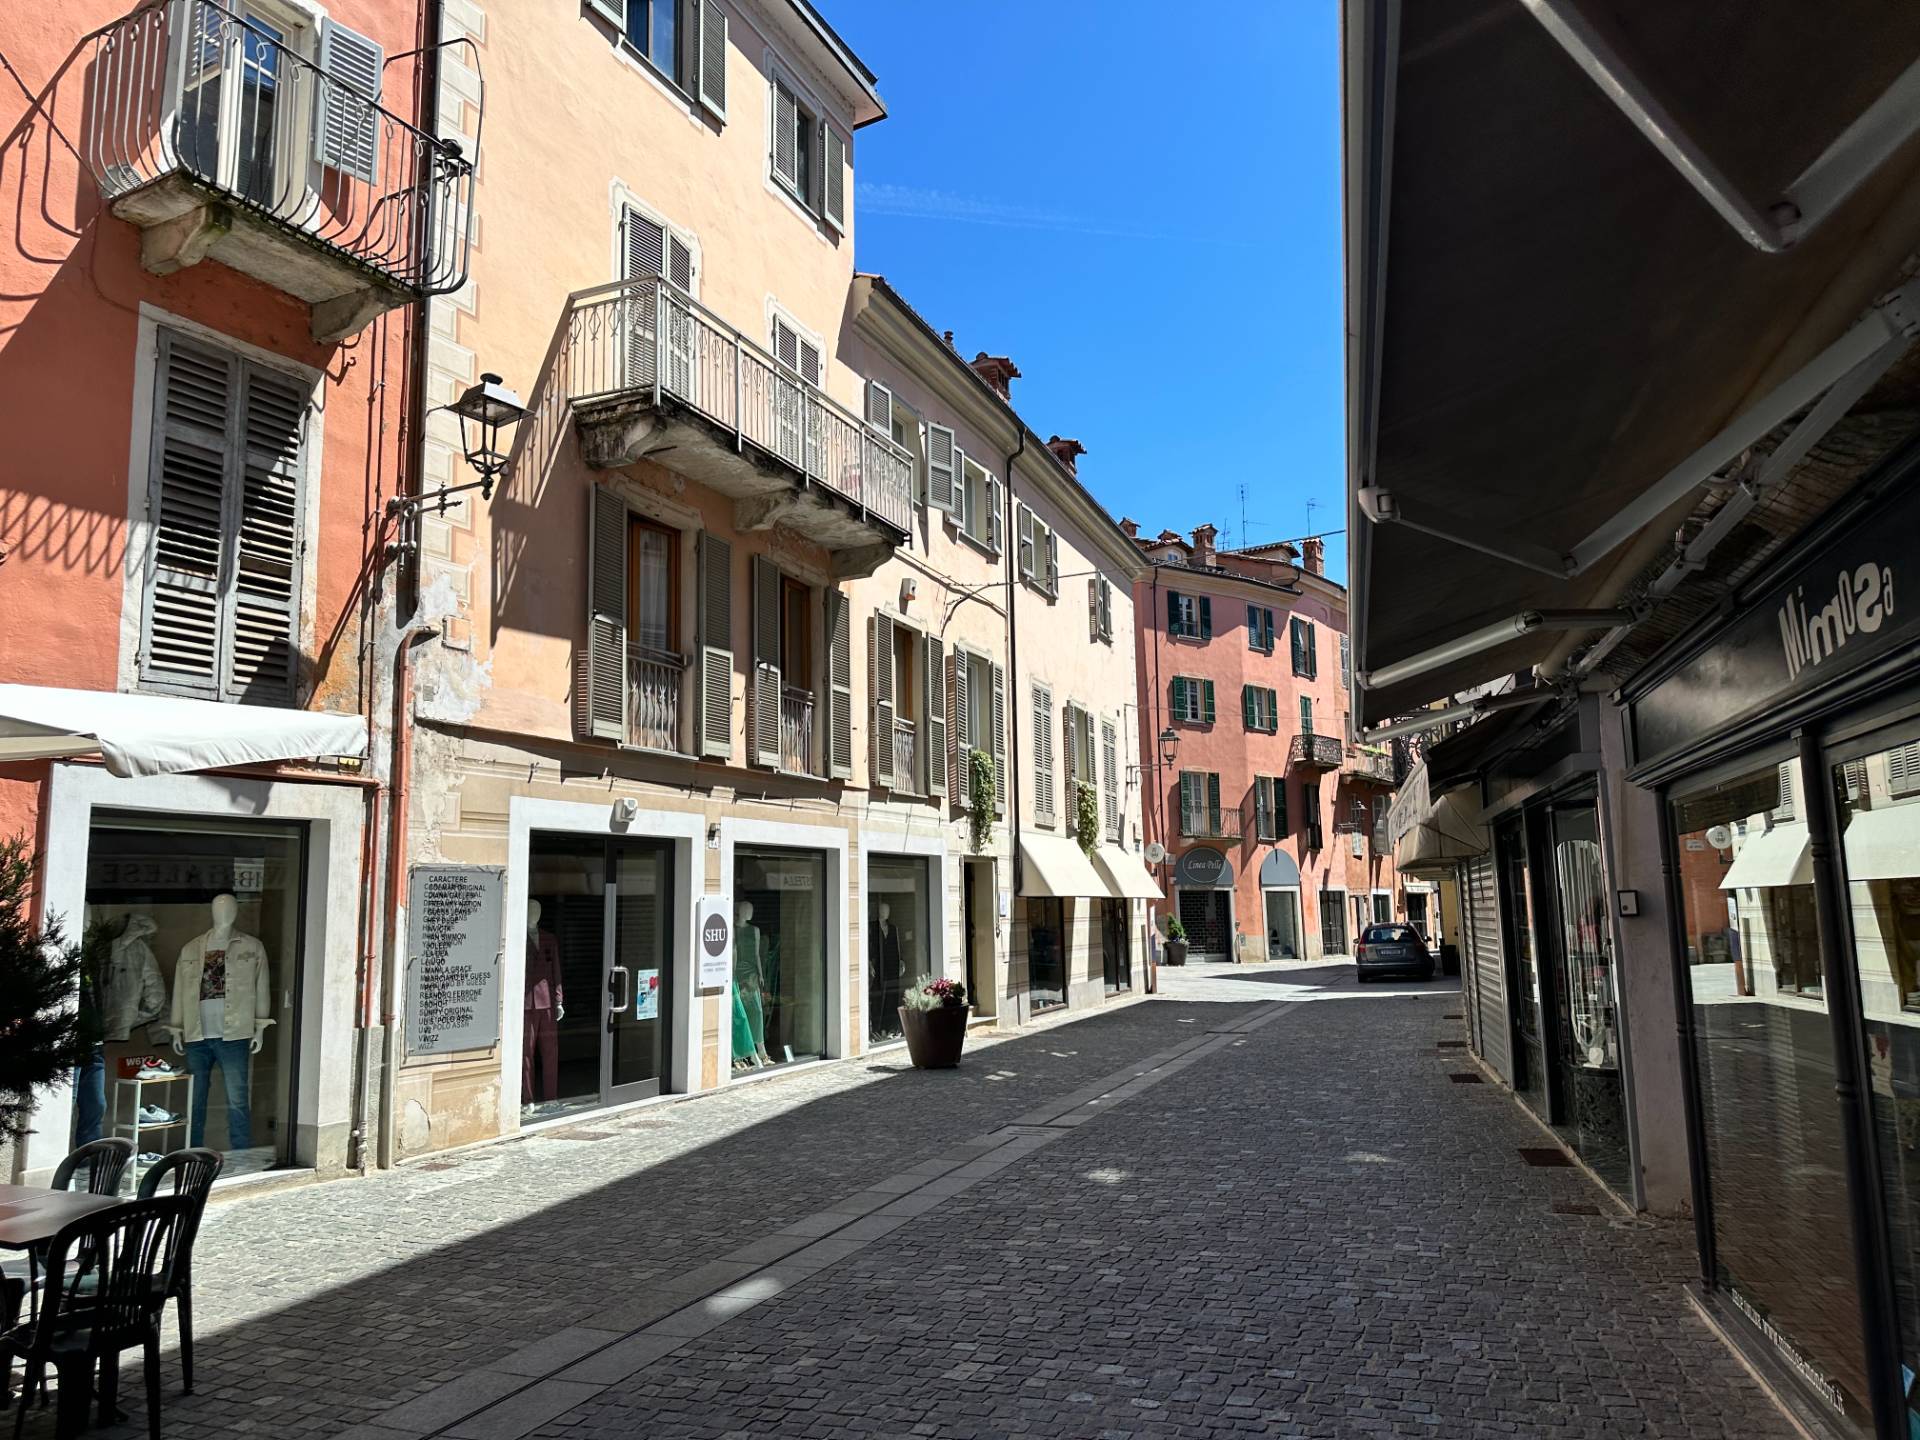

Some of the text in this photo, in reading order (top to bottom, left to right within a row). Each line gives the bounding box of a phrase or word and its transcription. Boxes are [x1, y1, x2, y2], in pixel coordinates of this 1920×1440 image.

[429, 875, 468, 883] CARACTERE
[704, 929, 726, 941] SHU
[470, 972, 491, 980] GUESS
[453, 988, 482, 998] FERRONE
[444, 1006, 473, 1016] ORIGINAL
[438, 1016, 455, 1024] POLO
